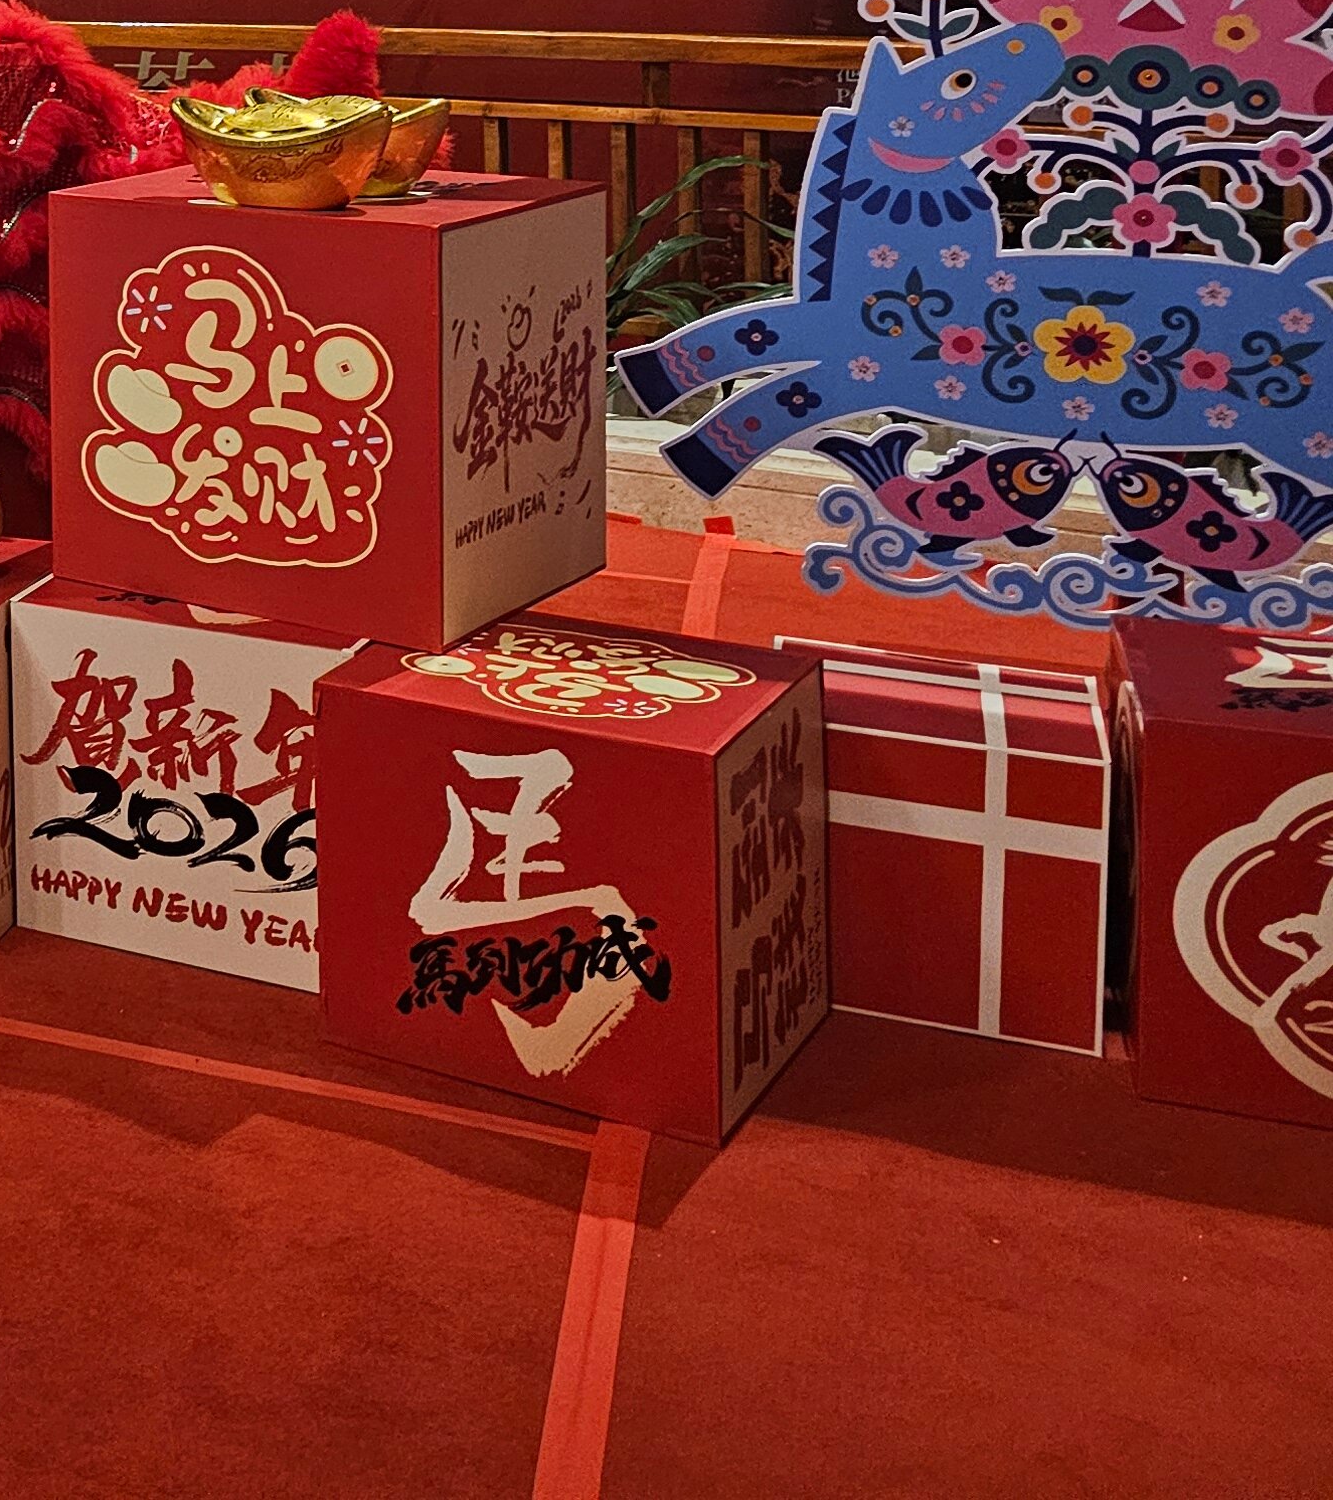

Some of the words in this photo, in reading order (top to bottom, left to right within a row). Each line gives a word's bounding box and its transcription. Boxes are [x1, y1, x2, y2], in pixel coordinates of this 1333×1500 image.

[455, 516, 485, 549] HAPPY
[486, 502, 517, 532] NEW
[517, 490, 547, 525] YEAR
[30, 763, 318, 894] 2026
[30, 863, 122, 912] HAPPY
[132, 889, 229, 932] NEW
[240, 908, 319, 953] YEA
